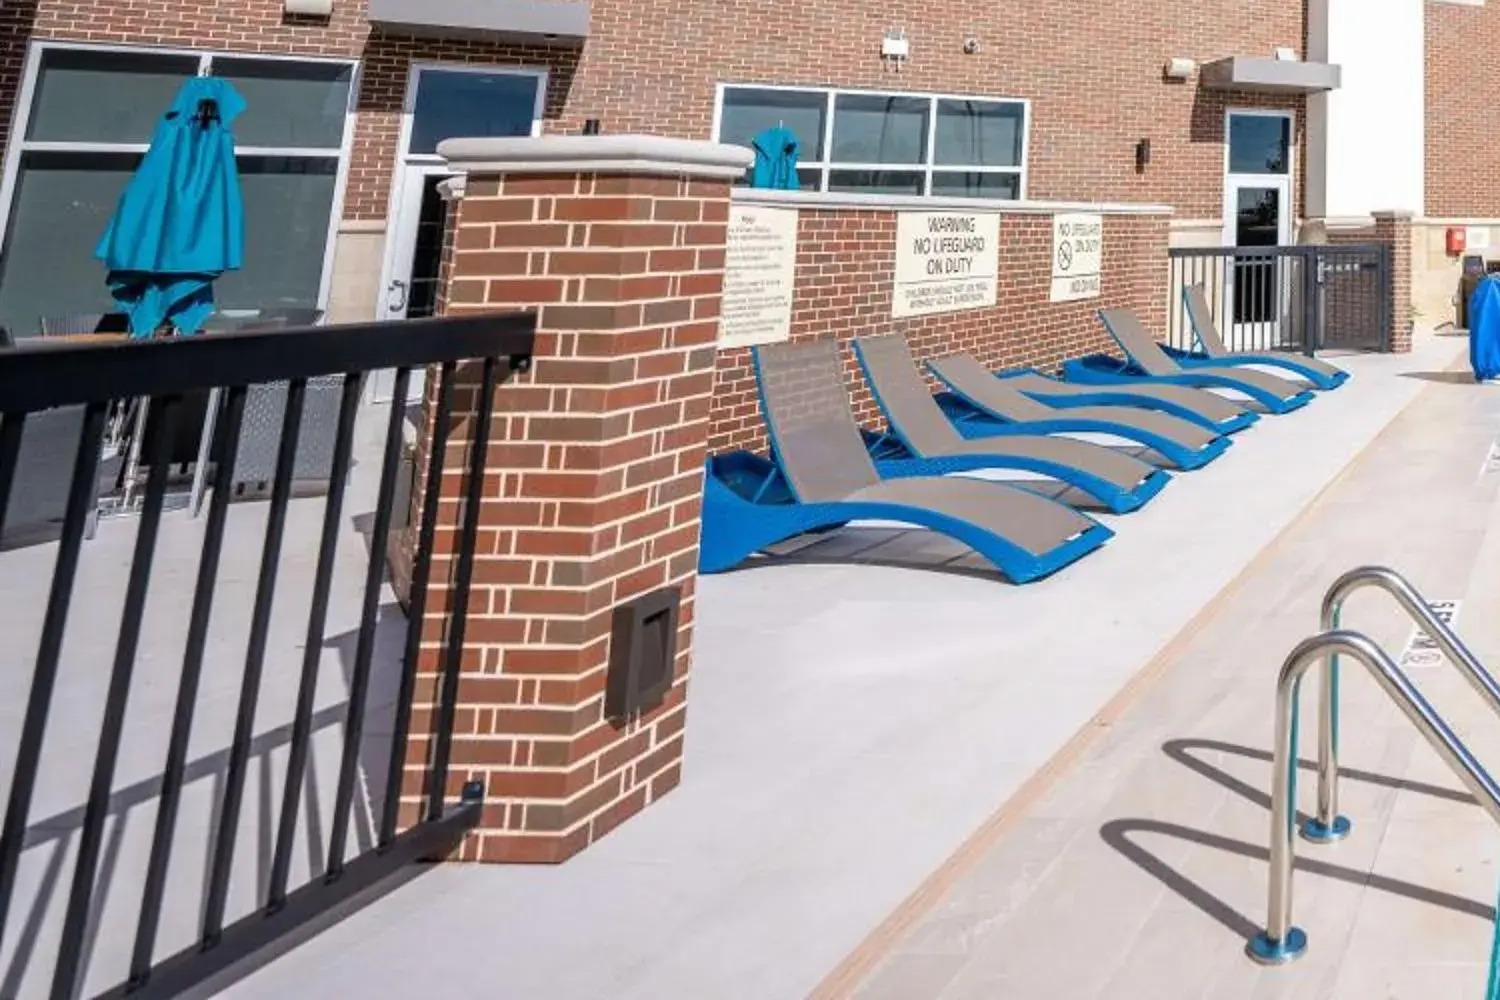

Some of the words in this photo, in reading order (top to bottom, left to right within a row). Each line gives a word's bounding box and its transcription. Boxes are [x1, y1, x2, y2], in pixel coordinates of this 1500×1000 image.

[927, 217, 976, 234] WARNING
[912, 237, 931, 255] NO
[933, 236, 985, 253] LIFEGUARD
[927, 258, 943, 275] ON
[945, 257, 973, 274] DUTY
